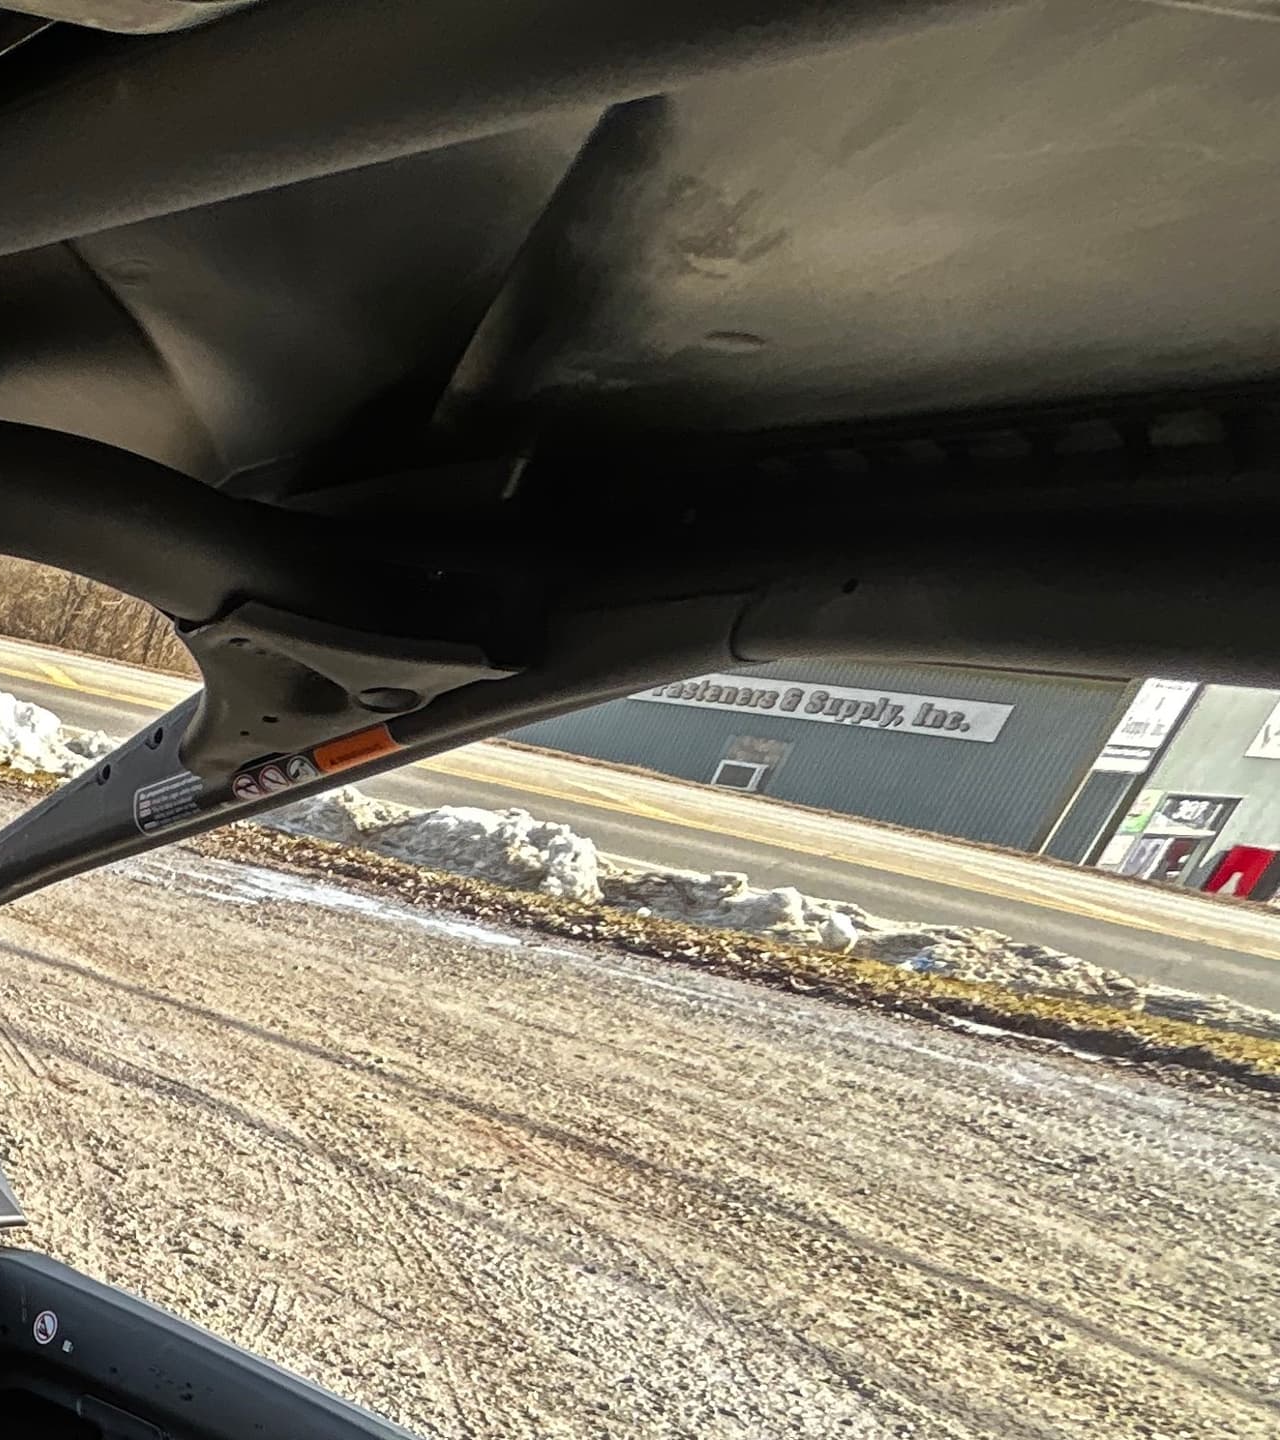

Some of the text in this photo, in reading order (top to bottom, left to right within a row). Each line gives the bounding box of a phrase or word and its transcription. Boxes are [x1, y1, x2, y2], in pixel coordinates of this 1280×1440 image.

[779, 687, 805, 713] &
[804, 690, 905, 728] Supply,
[911, 702, 972, 733] Inc.
